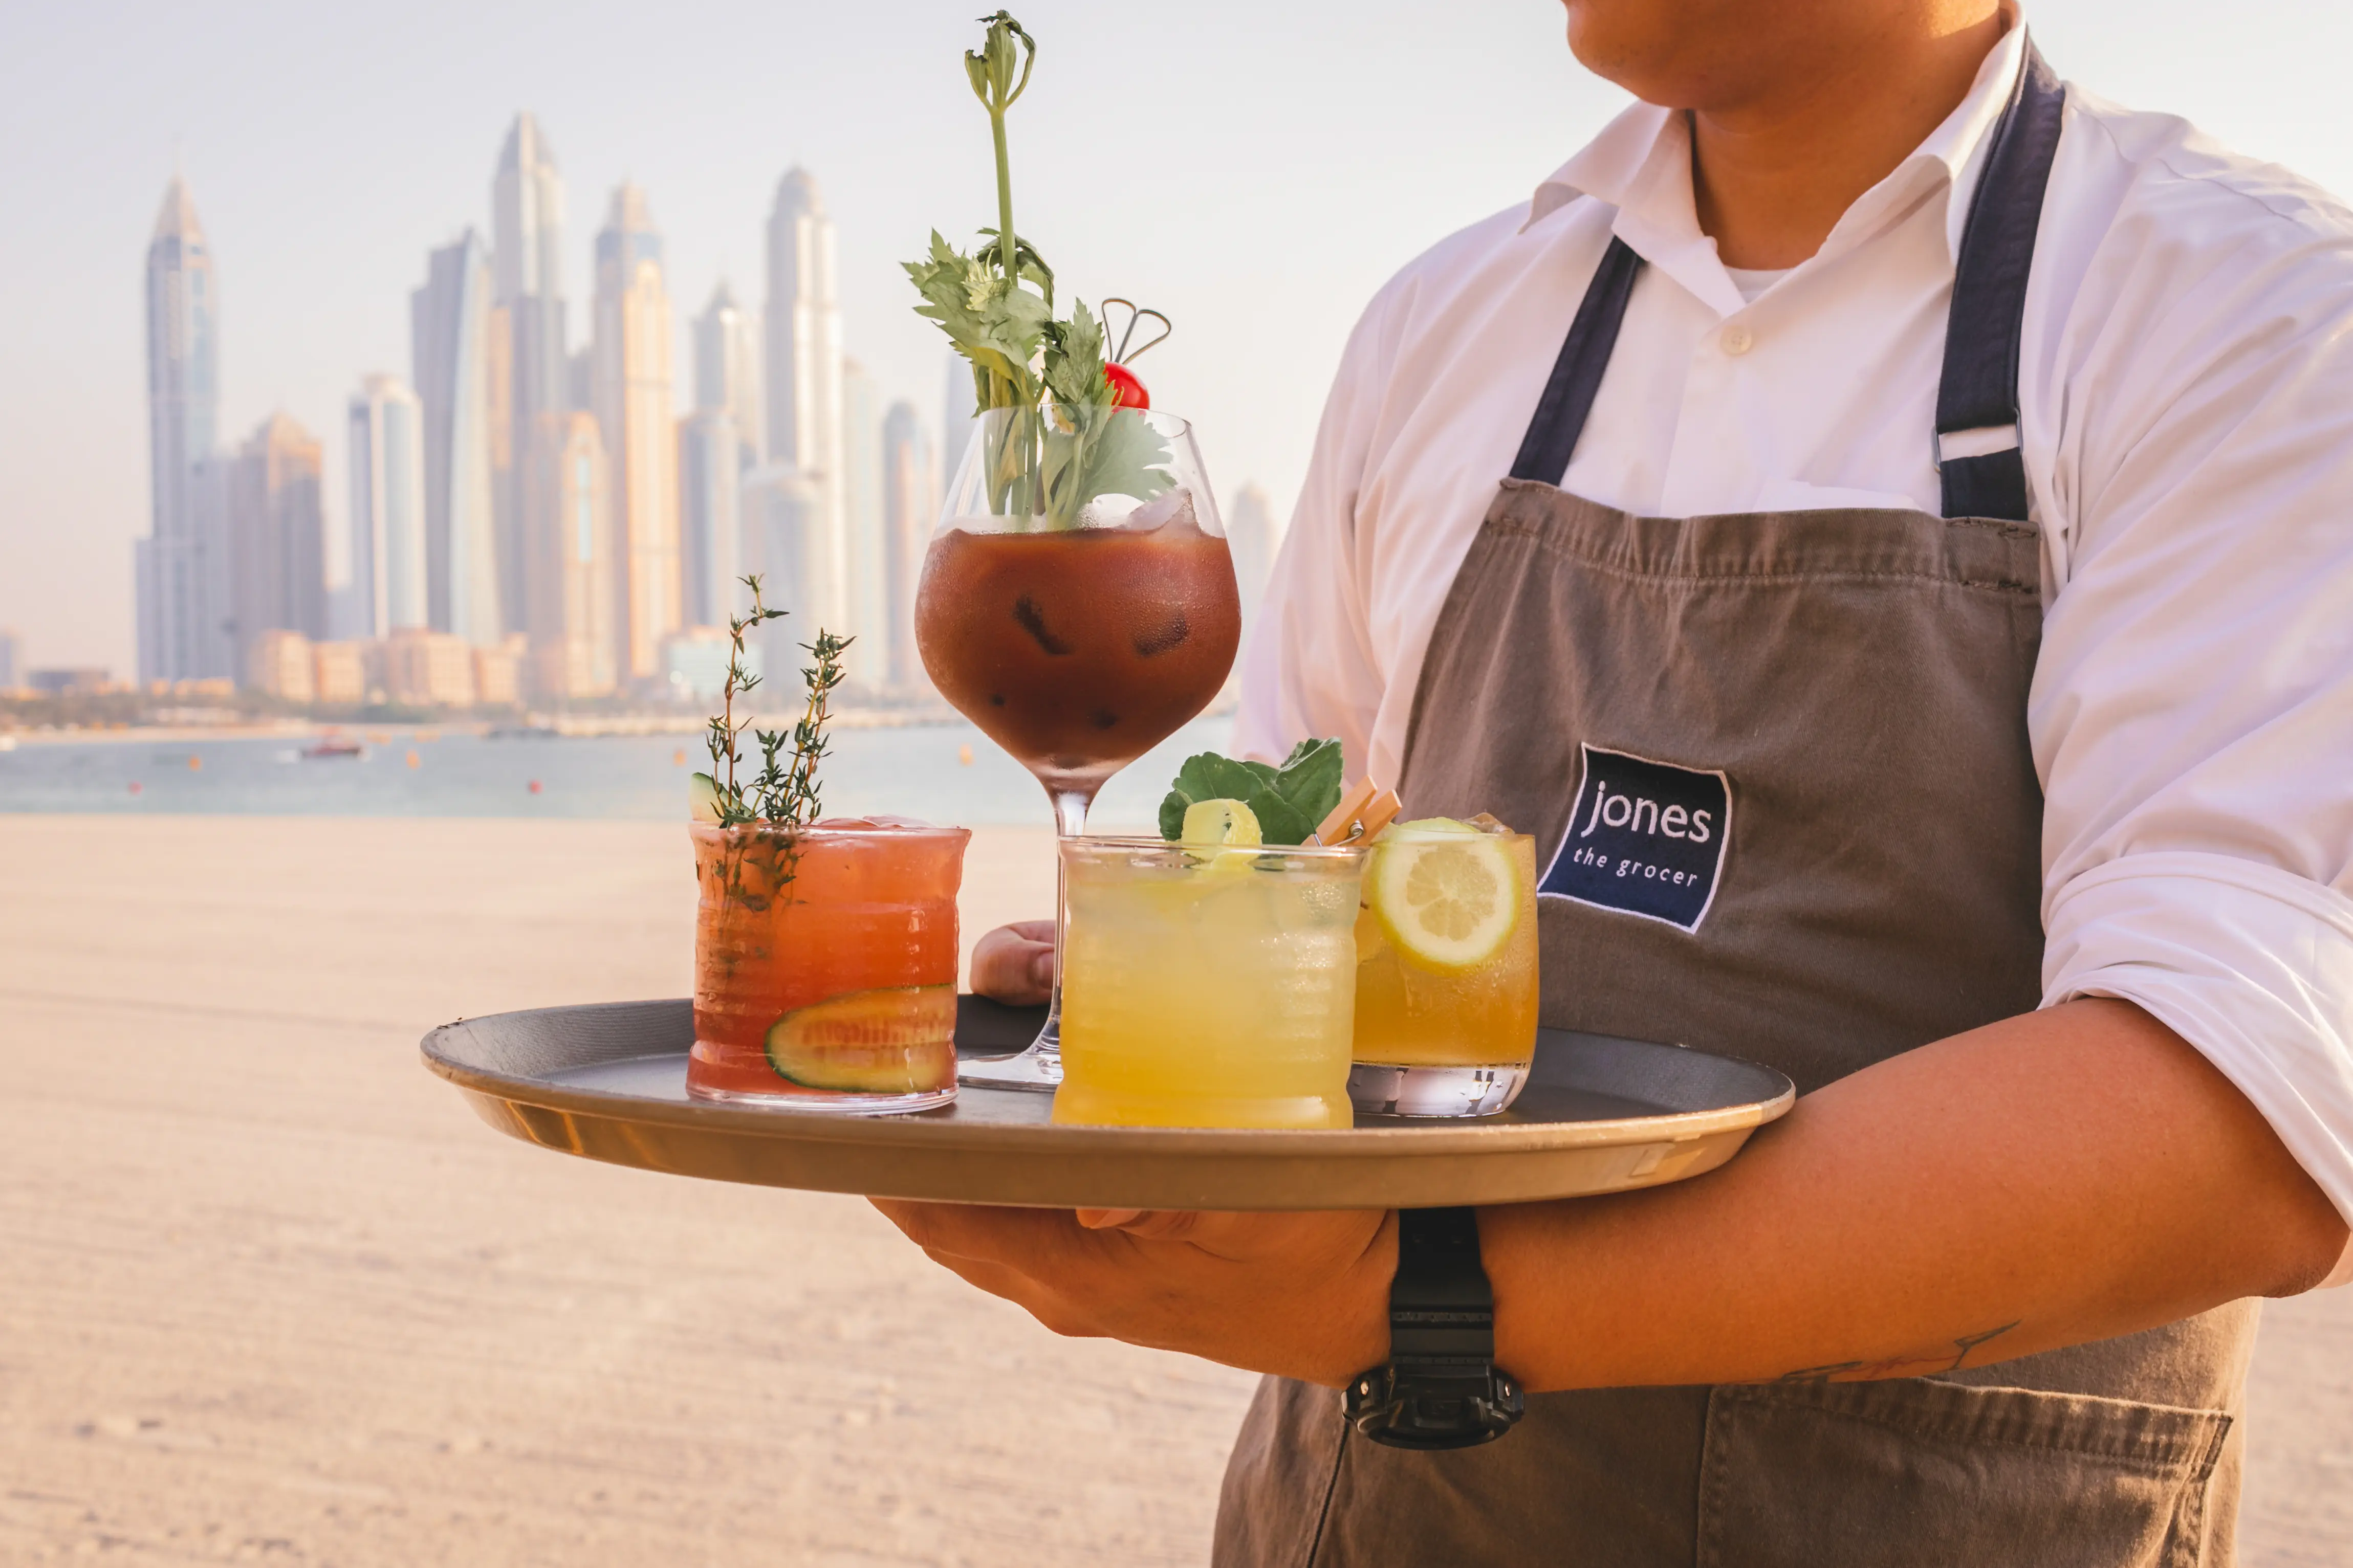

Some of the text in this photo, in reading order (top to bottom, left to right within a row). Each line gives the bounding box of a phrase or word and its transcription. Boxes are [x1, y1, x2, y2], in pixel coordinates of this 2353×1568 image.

[1581, 781, 1711, 843] jones
[1573, 847, 1697, 887] the grocer
